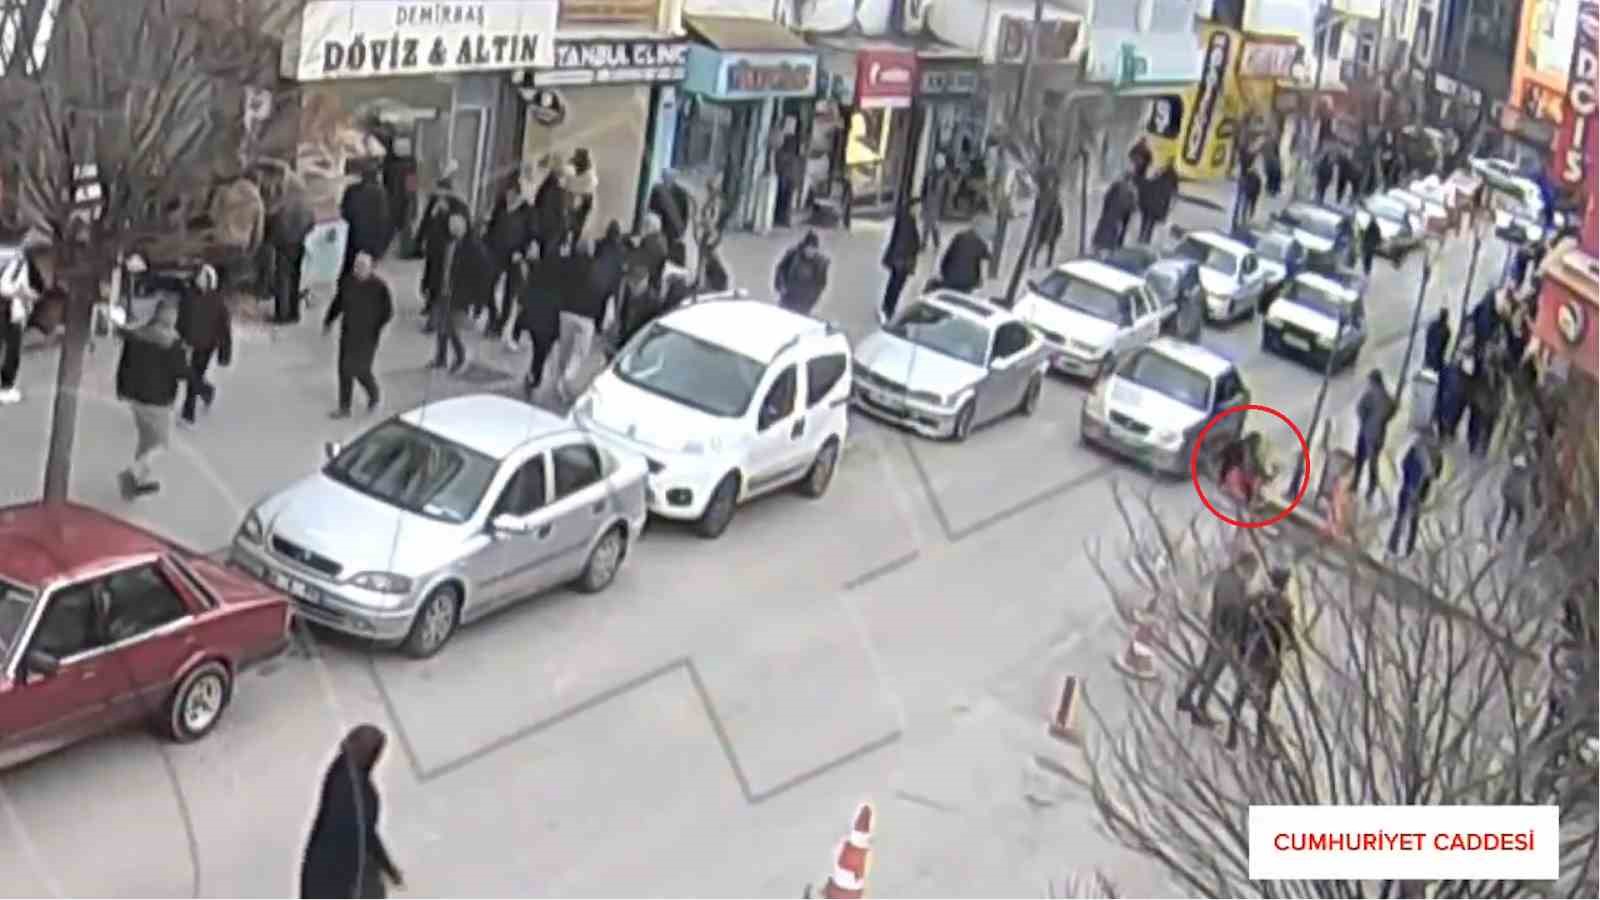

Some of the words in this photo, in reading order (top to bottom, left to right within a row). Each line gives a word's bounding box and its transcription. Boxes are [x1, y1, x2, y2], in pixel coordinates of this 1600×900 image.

[323, 33, 418, 72] DÖVİZ
[428, 35, 447, 63] &
[456, 34, 539, 66] ALTIN
